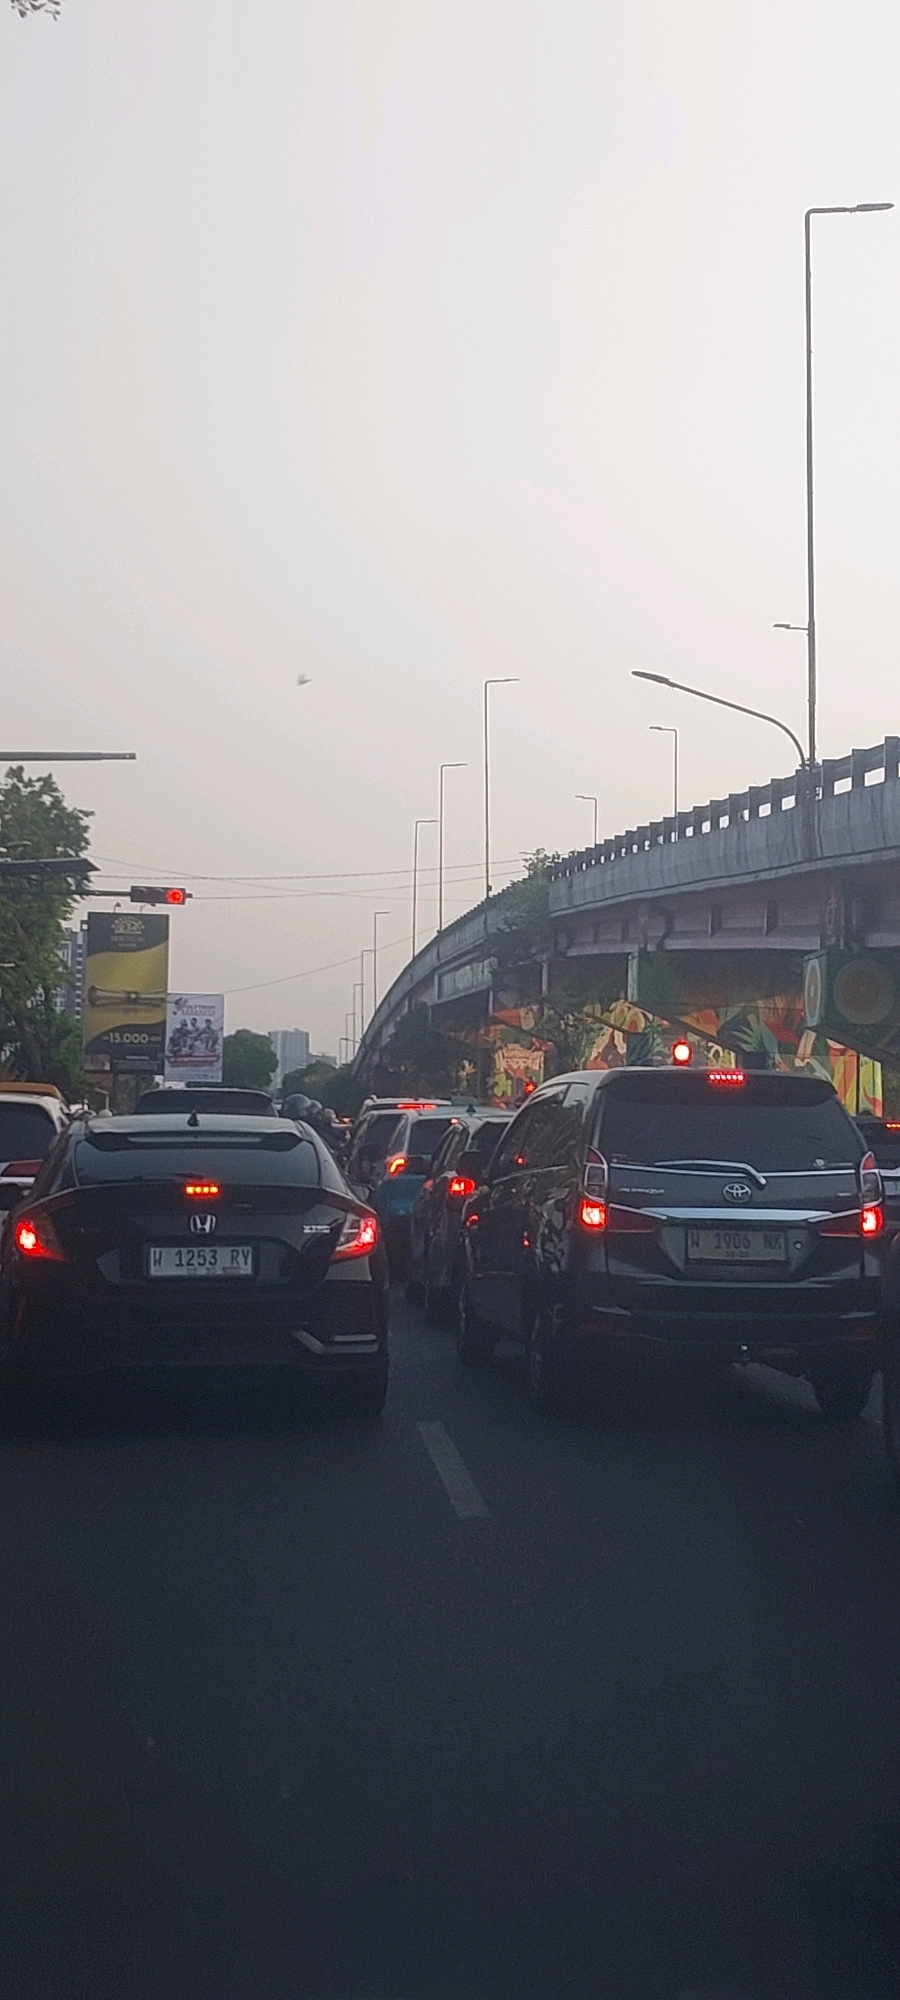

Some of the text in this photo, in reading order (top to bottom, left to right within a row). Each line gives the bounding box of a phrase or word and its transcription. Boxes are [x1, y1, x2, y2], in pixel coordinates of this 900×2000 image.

[109, 1032, 149, 1044] 15.000
[174, 1249, 218, 1267] 1253
[230, 1249, 250, 1266] RY
